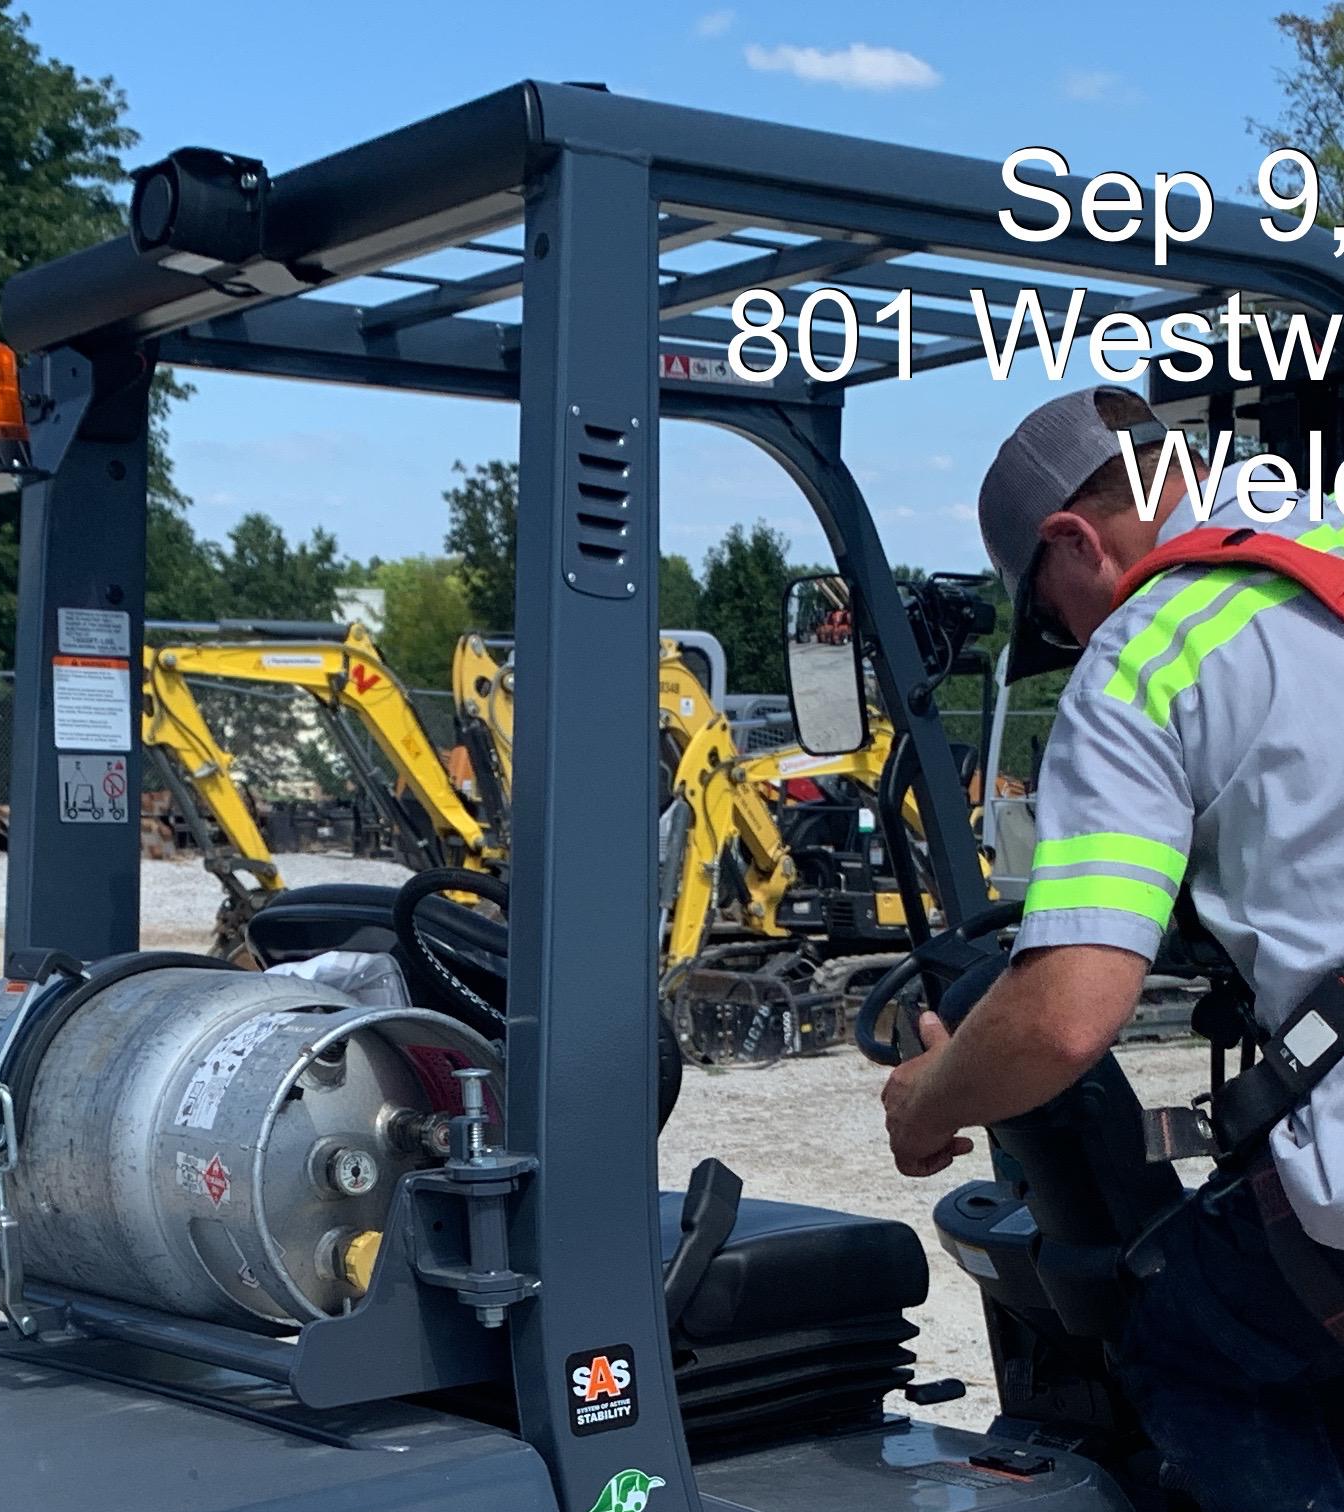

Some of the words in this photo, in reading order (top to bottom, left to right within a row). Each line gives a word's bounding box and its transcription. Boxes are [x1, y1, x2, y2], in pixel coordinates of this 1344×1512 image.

[572, 1355, 632, 1402] SAS
[576, 1404, 600, 1415] SYSTEM
[600, 1402, 609, 1410] OF
[609, 1398, 631, 1408] ACTIVE
[577, 1405, 631, 1425] STABILITY
